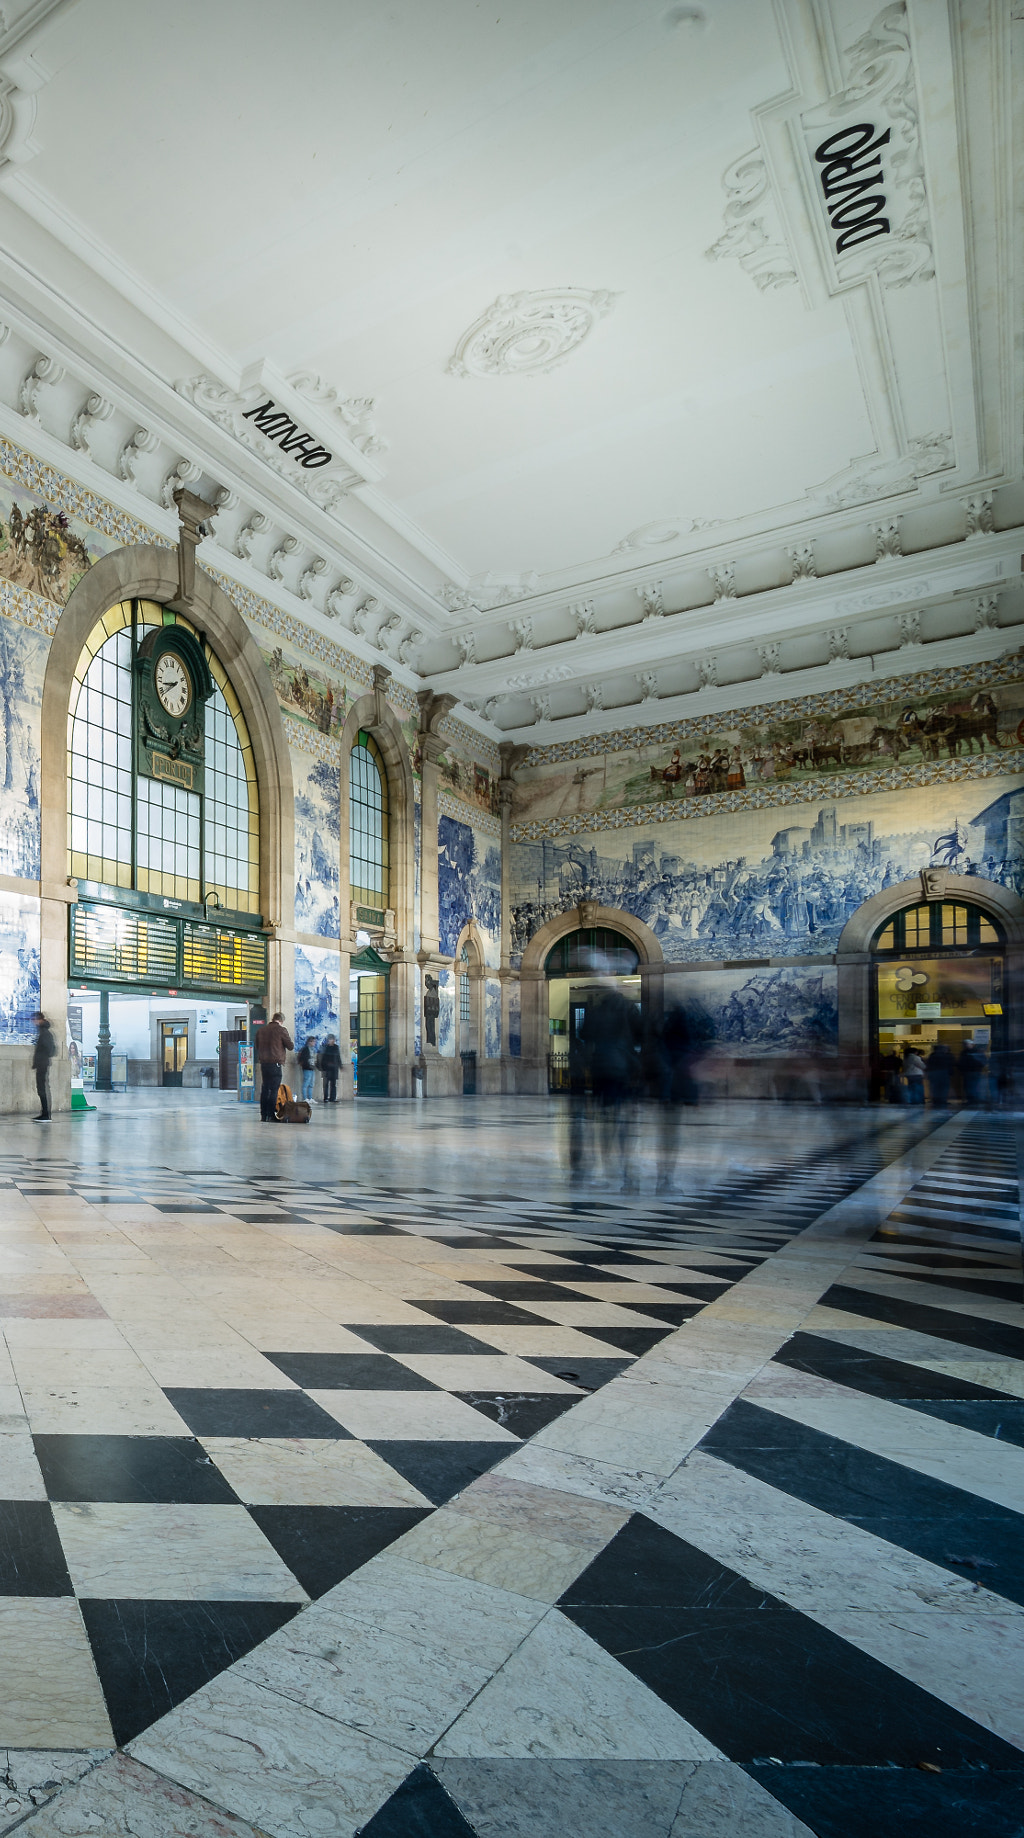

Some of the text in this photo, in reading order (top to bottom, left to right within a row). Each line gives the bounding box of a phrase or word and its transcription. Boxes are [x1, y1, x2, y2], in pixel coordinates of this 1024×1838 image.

[815, 123, 891, 255] DOURO
[242, 399, 332, 469] MINHO
[159, 758, 187, 780] PORTO
[889, 992, 930, 1003] CENTRO
[896, 1000, 967, 1011] MOADE
